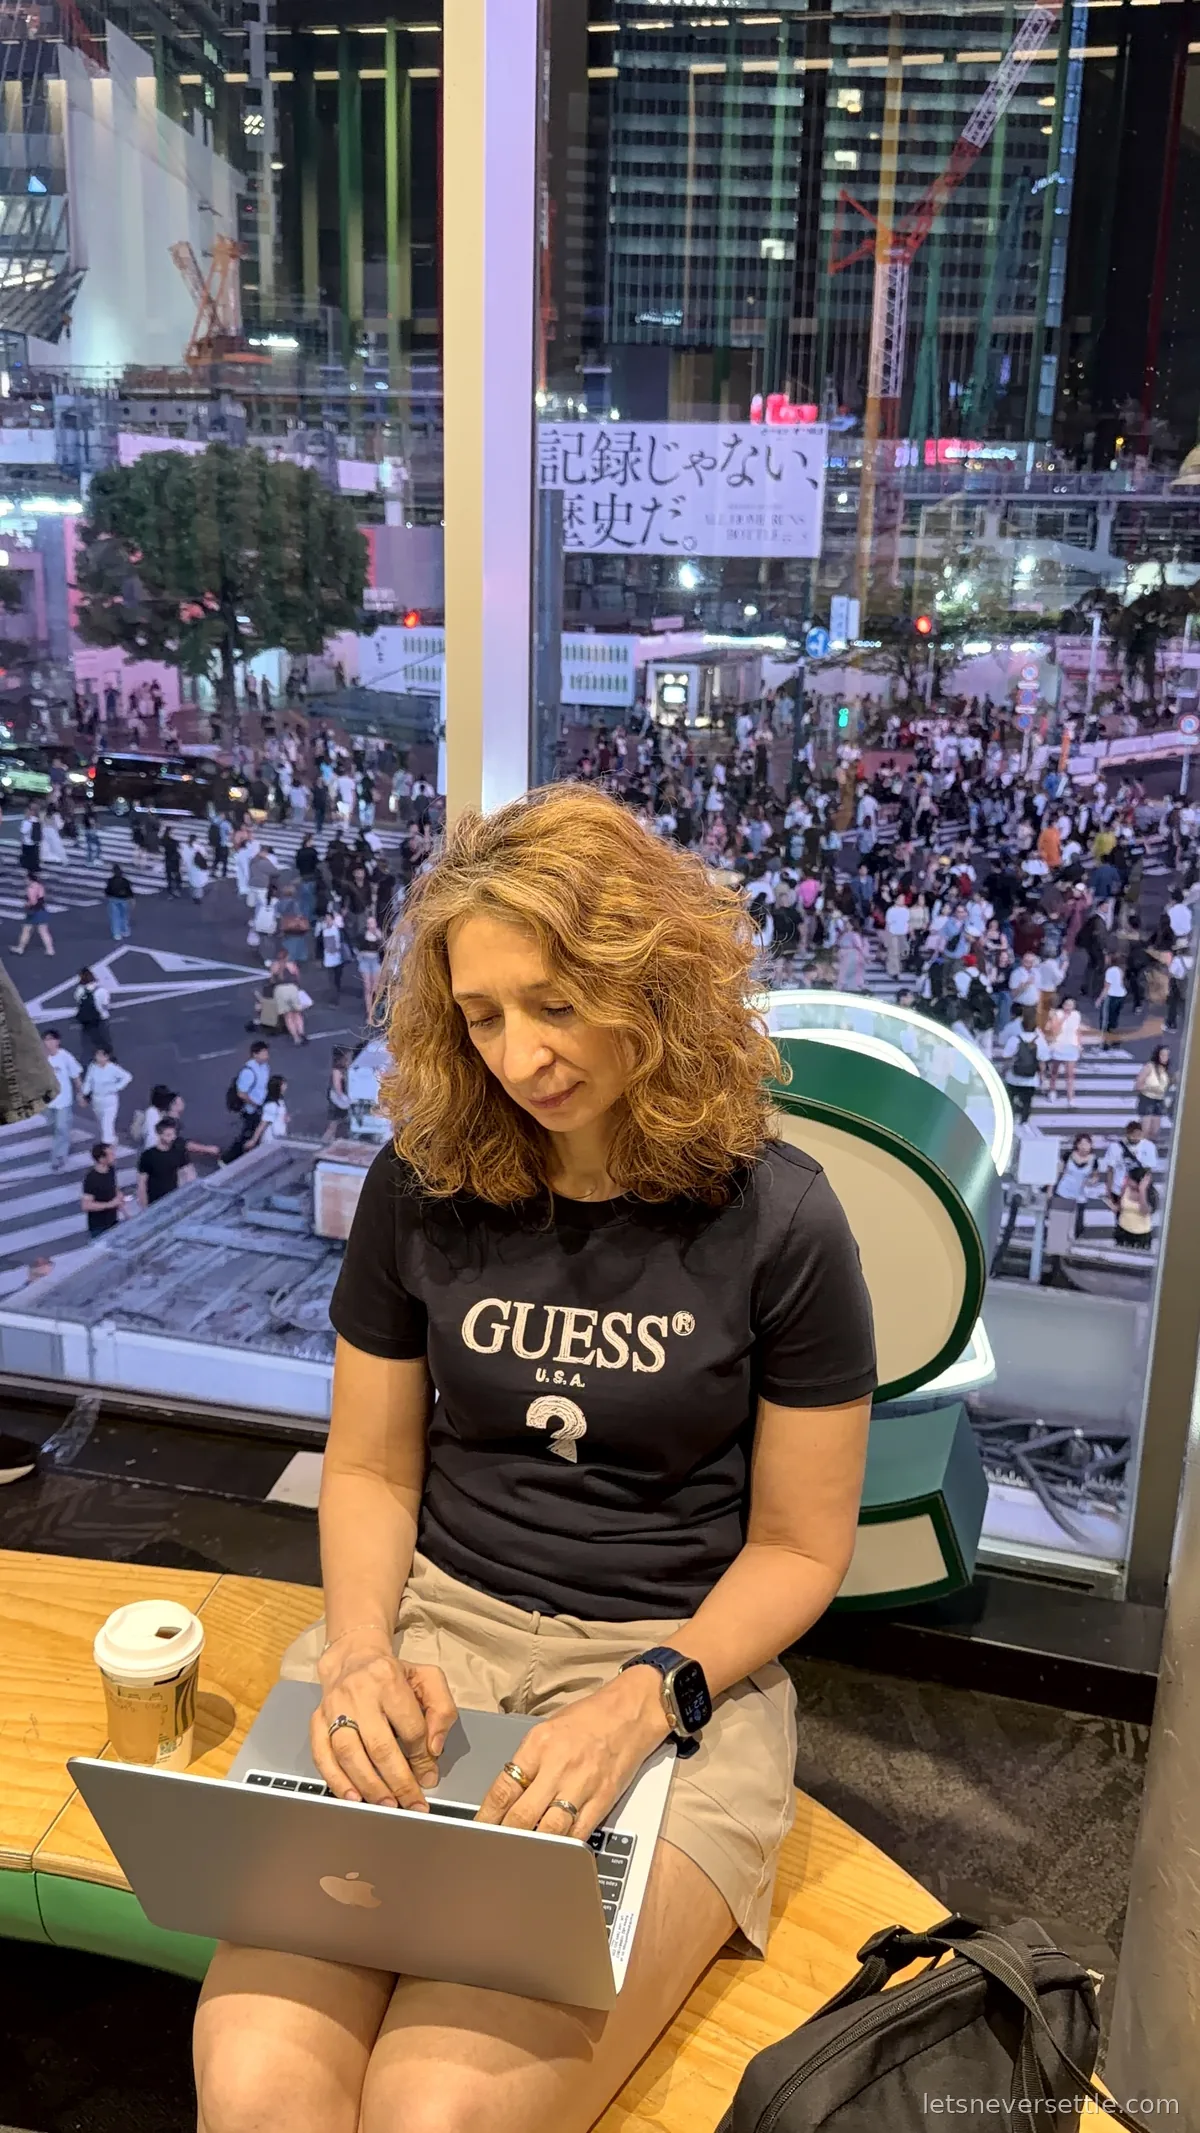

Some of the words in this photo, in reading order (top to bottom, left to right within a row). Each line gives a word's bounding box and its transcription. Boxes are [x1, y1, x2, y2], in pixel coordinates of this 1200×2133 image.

[537, 429, 819, 490] 記録じゃない、
